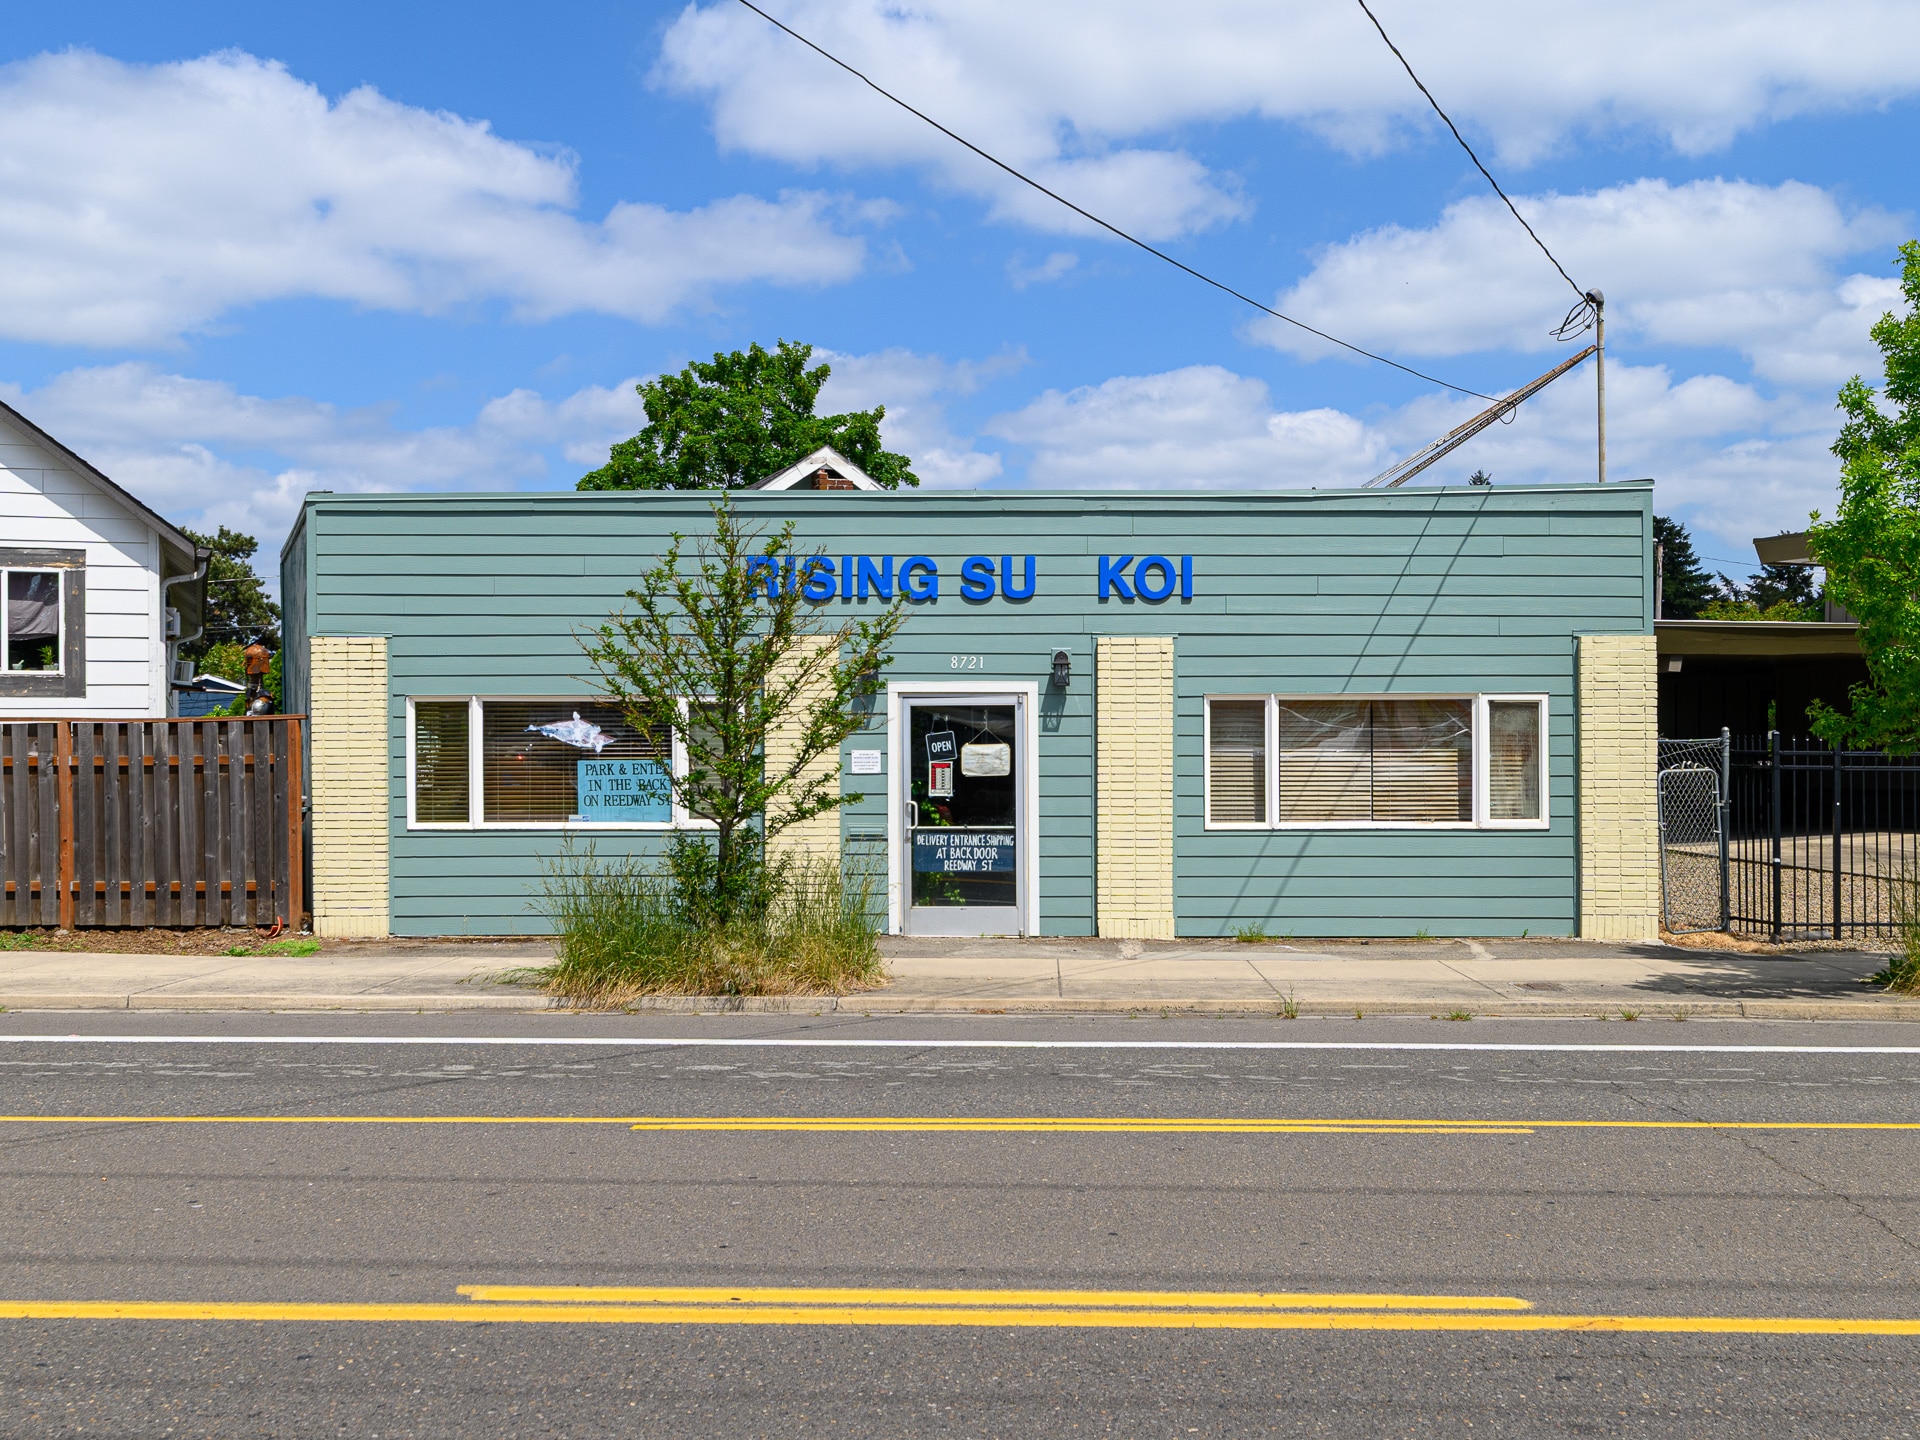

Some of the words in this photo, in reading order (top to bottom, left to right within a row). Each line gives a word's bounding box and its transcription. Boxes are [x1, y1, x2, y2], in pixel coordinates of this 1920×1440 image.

[746, 555, 940, 600] RISING
[960, 555, 1036, 600] SU
[1098, 554, 1193, 600] KOI
[950, 655, 984, 669] 8721
[931, 740, 952, 753] OPEN
[585, 763, 615, 776] PARK
[618, 764, 628, 776] &
[588, 779, 602, 792] IN
[608, 778, 632, 791] THE
[637, 778, 668, 792] BACK
[583, 794, 599, 807] ON
[603, 793, 652, 807] REEDWAY
[950, 834, 986, 846] ENTRANCE
[936, 847, 947, 859] AT
[950, 847, 973, 860] BACK
[973, 847, 998, 860] DOOR
[944, 860, 977, 871] REEDWAY
[981, 860, 993, 871] ST
